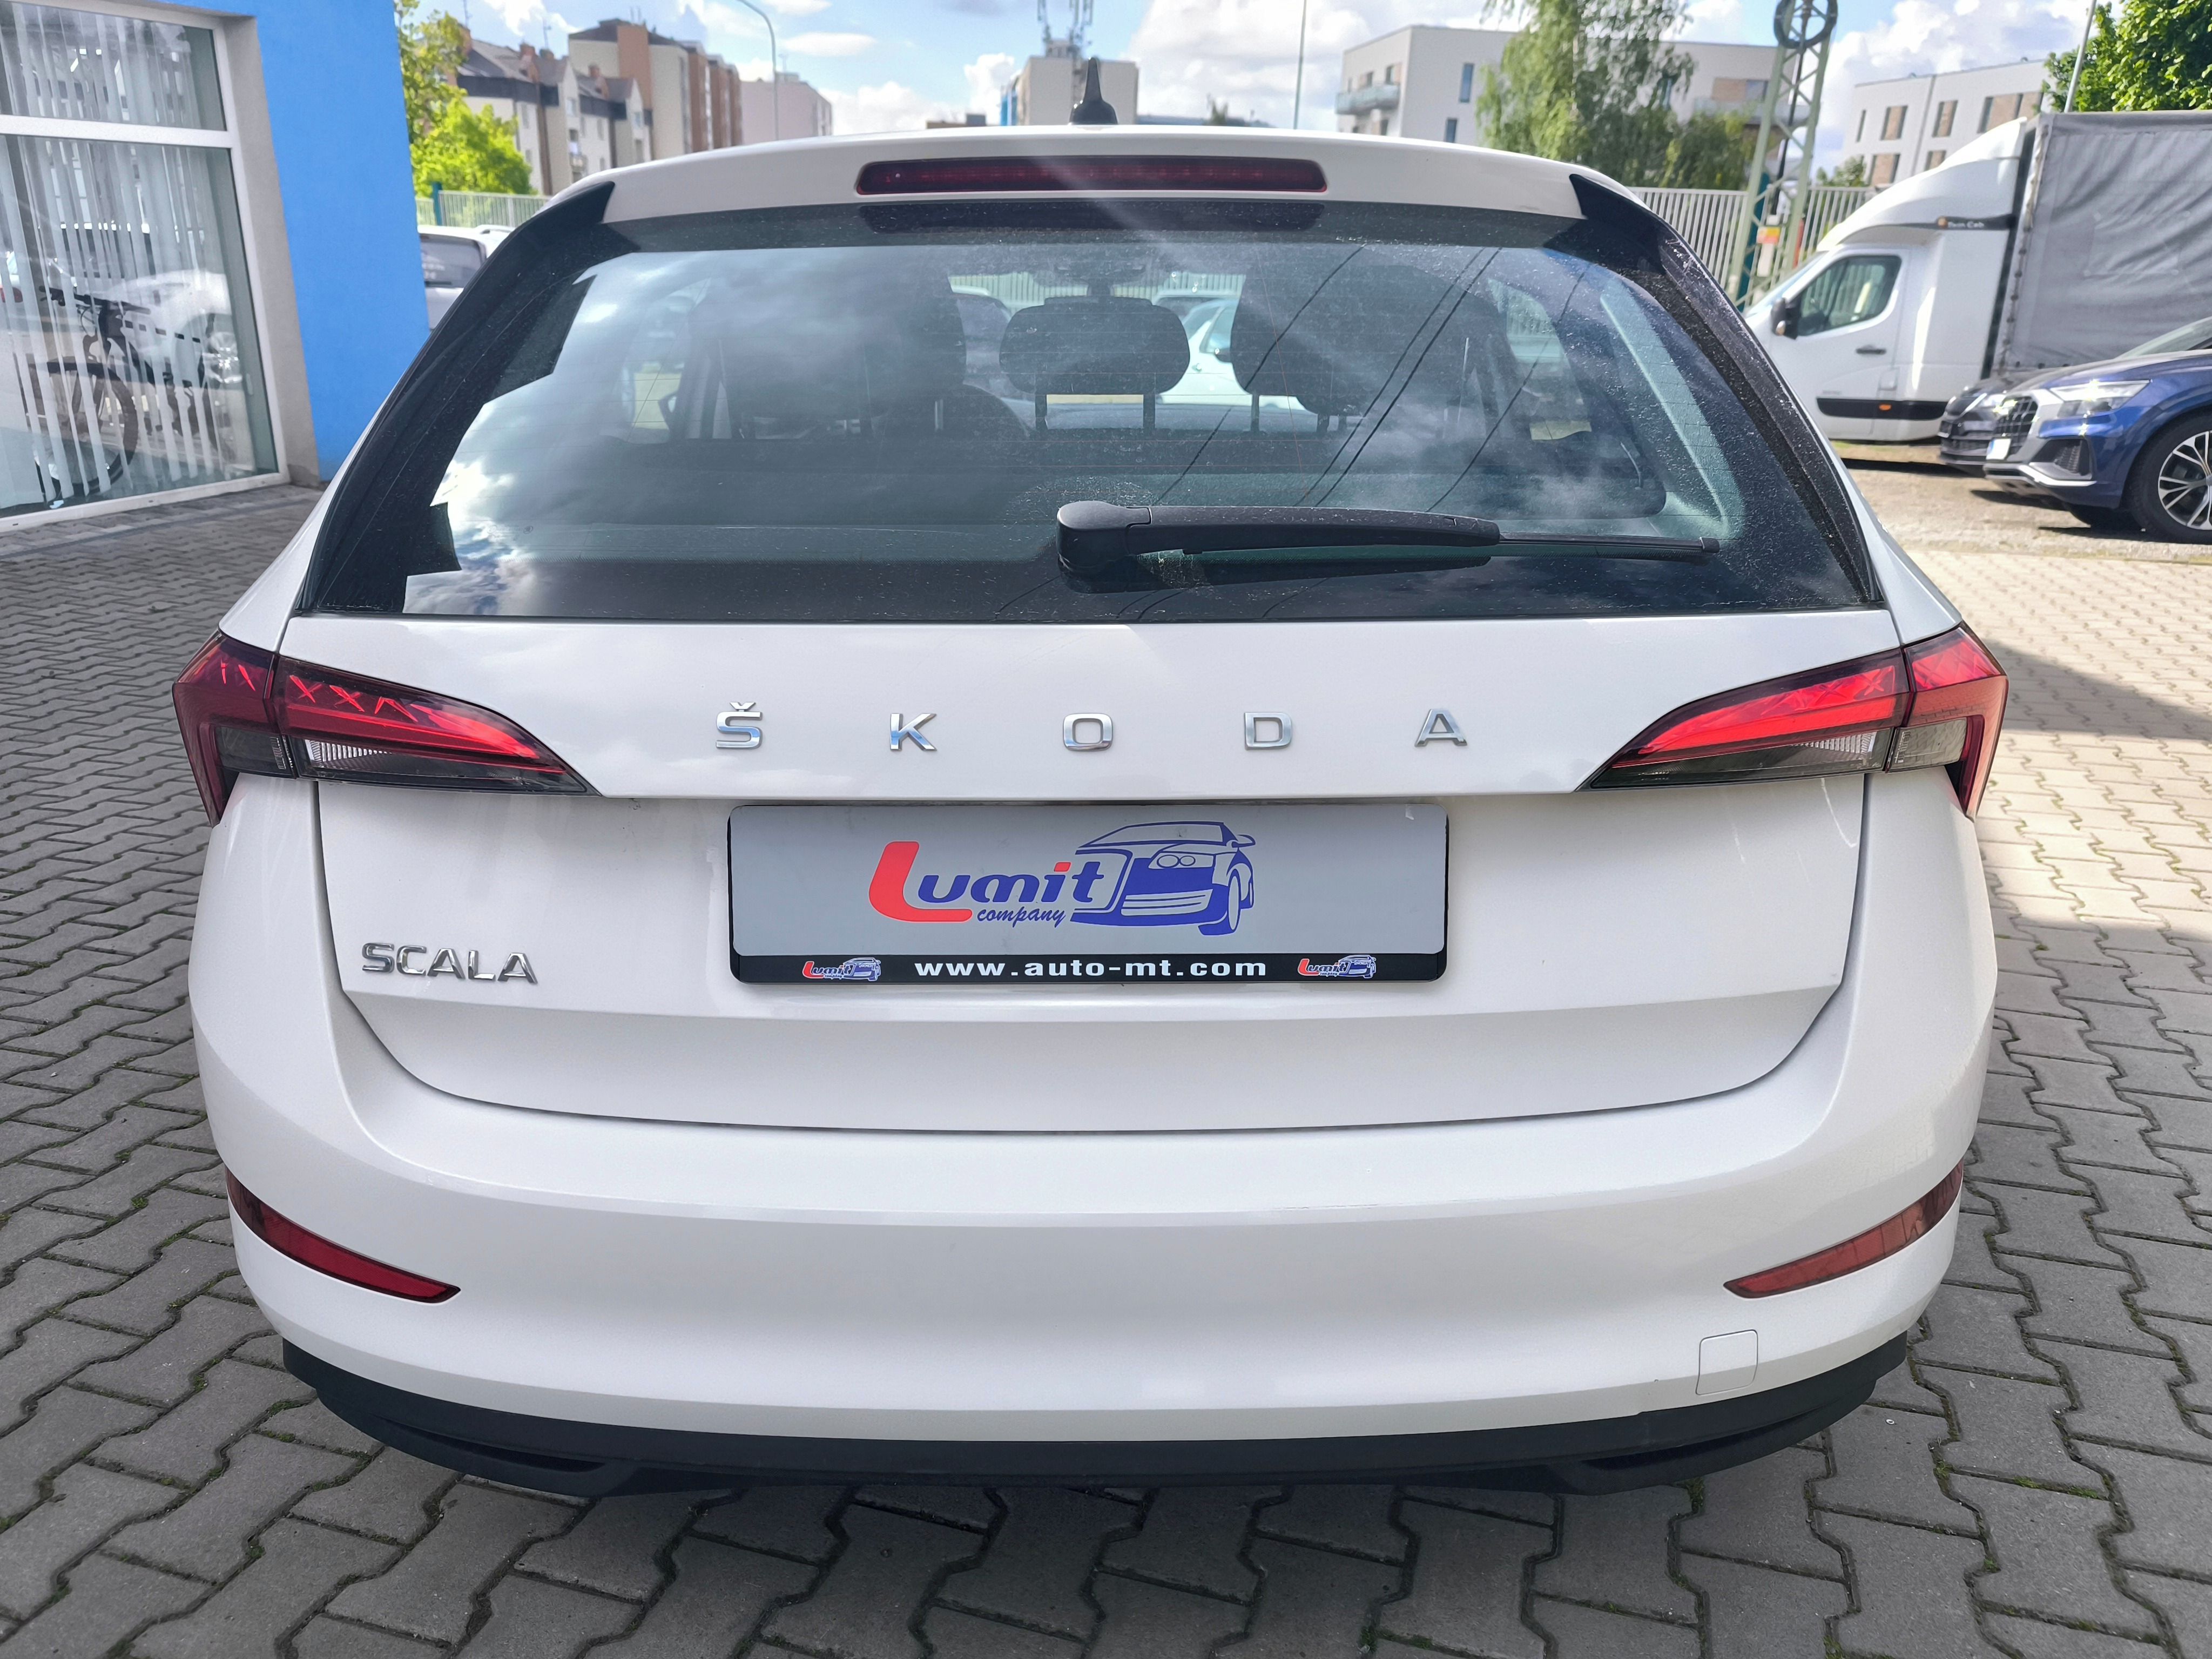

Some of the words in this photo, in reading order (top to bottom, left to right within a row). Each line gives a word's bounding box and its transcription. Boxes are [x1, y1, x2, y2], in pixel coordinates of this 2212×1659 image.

[716, 702, 1468, 752] ŠKODA
[868, 841, 1105, 923] Lumit
[977, 906, 1066, 928] company
[361, 942, 538, 984] SCALA
[802, 961, 852, 979] Lumit
[914, 959, 1266, 976] www.auto-mt.com
[1298, 958, 1346, 976] Lumit
